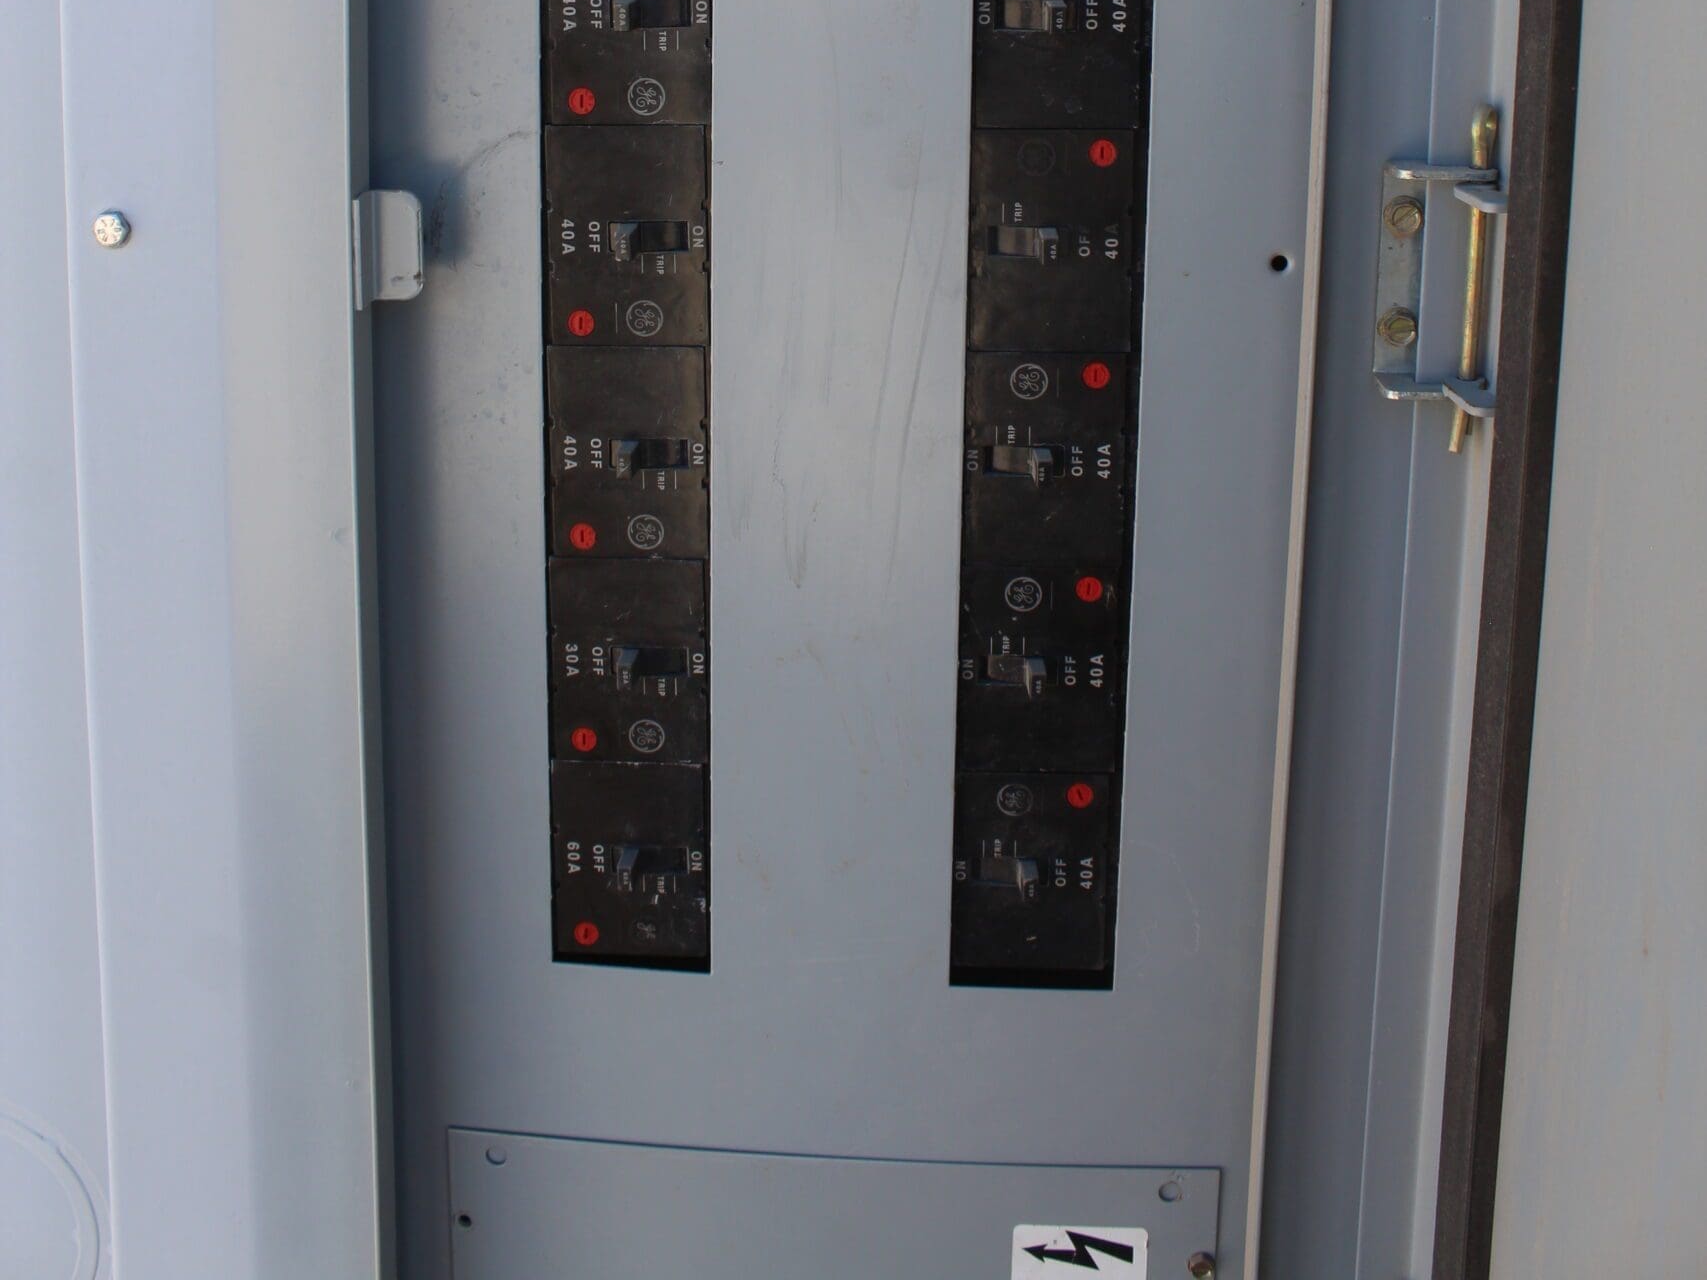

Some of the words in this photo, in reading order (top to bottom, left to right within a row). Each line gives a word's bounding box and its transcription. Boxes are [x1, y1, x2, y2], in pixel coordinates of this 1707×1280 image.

[696, 1, 707, 24] ON
[979, 2, 990, 24] ON
[659, 31, 667, 52] TRIP
[1014, 202, 1022, 223] TRIP
[561, 219, 575, 255] 40A
[588, 221, 600, 253] OFF
[692, 226, 704, 248] ON
[656, 255, 664, 274] TRIP
[564, 436, 578, 470] 40A
[590, 438, 602, 469] OFF
[693, 443, 704, 465] ON
[967, 449, 978, 470] ON
[1071, 446, 1083, 476] OFF
[1097, 444, 1111, 479] 40A
[565, 644, 579, 677] 30A
[592, 647, 603, 675] OFF
[692, 653, 704, 674] ON
[962, 659, 973, 680] ON
[1065, 656, 1076, 685] OFF
[1090, 655, 1104, 688] 40A
[567, 842, 581, 873] 60A
[593, 845, 604, 873] OFF
[691, 851, 702, 871] ON
[955, 861, 966, 880] ON
[657, 876, 665, 894] TRIP
[1055, 859, 1066, 887] OFF
[1080, 858, 1093, 889] 40A
